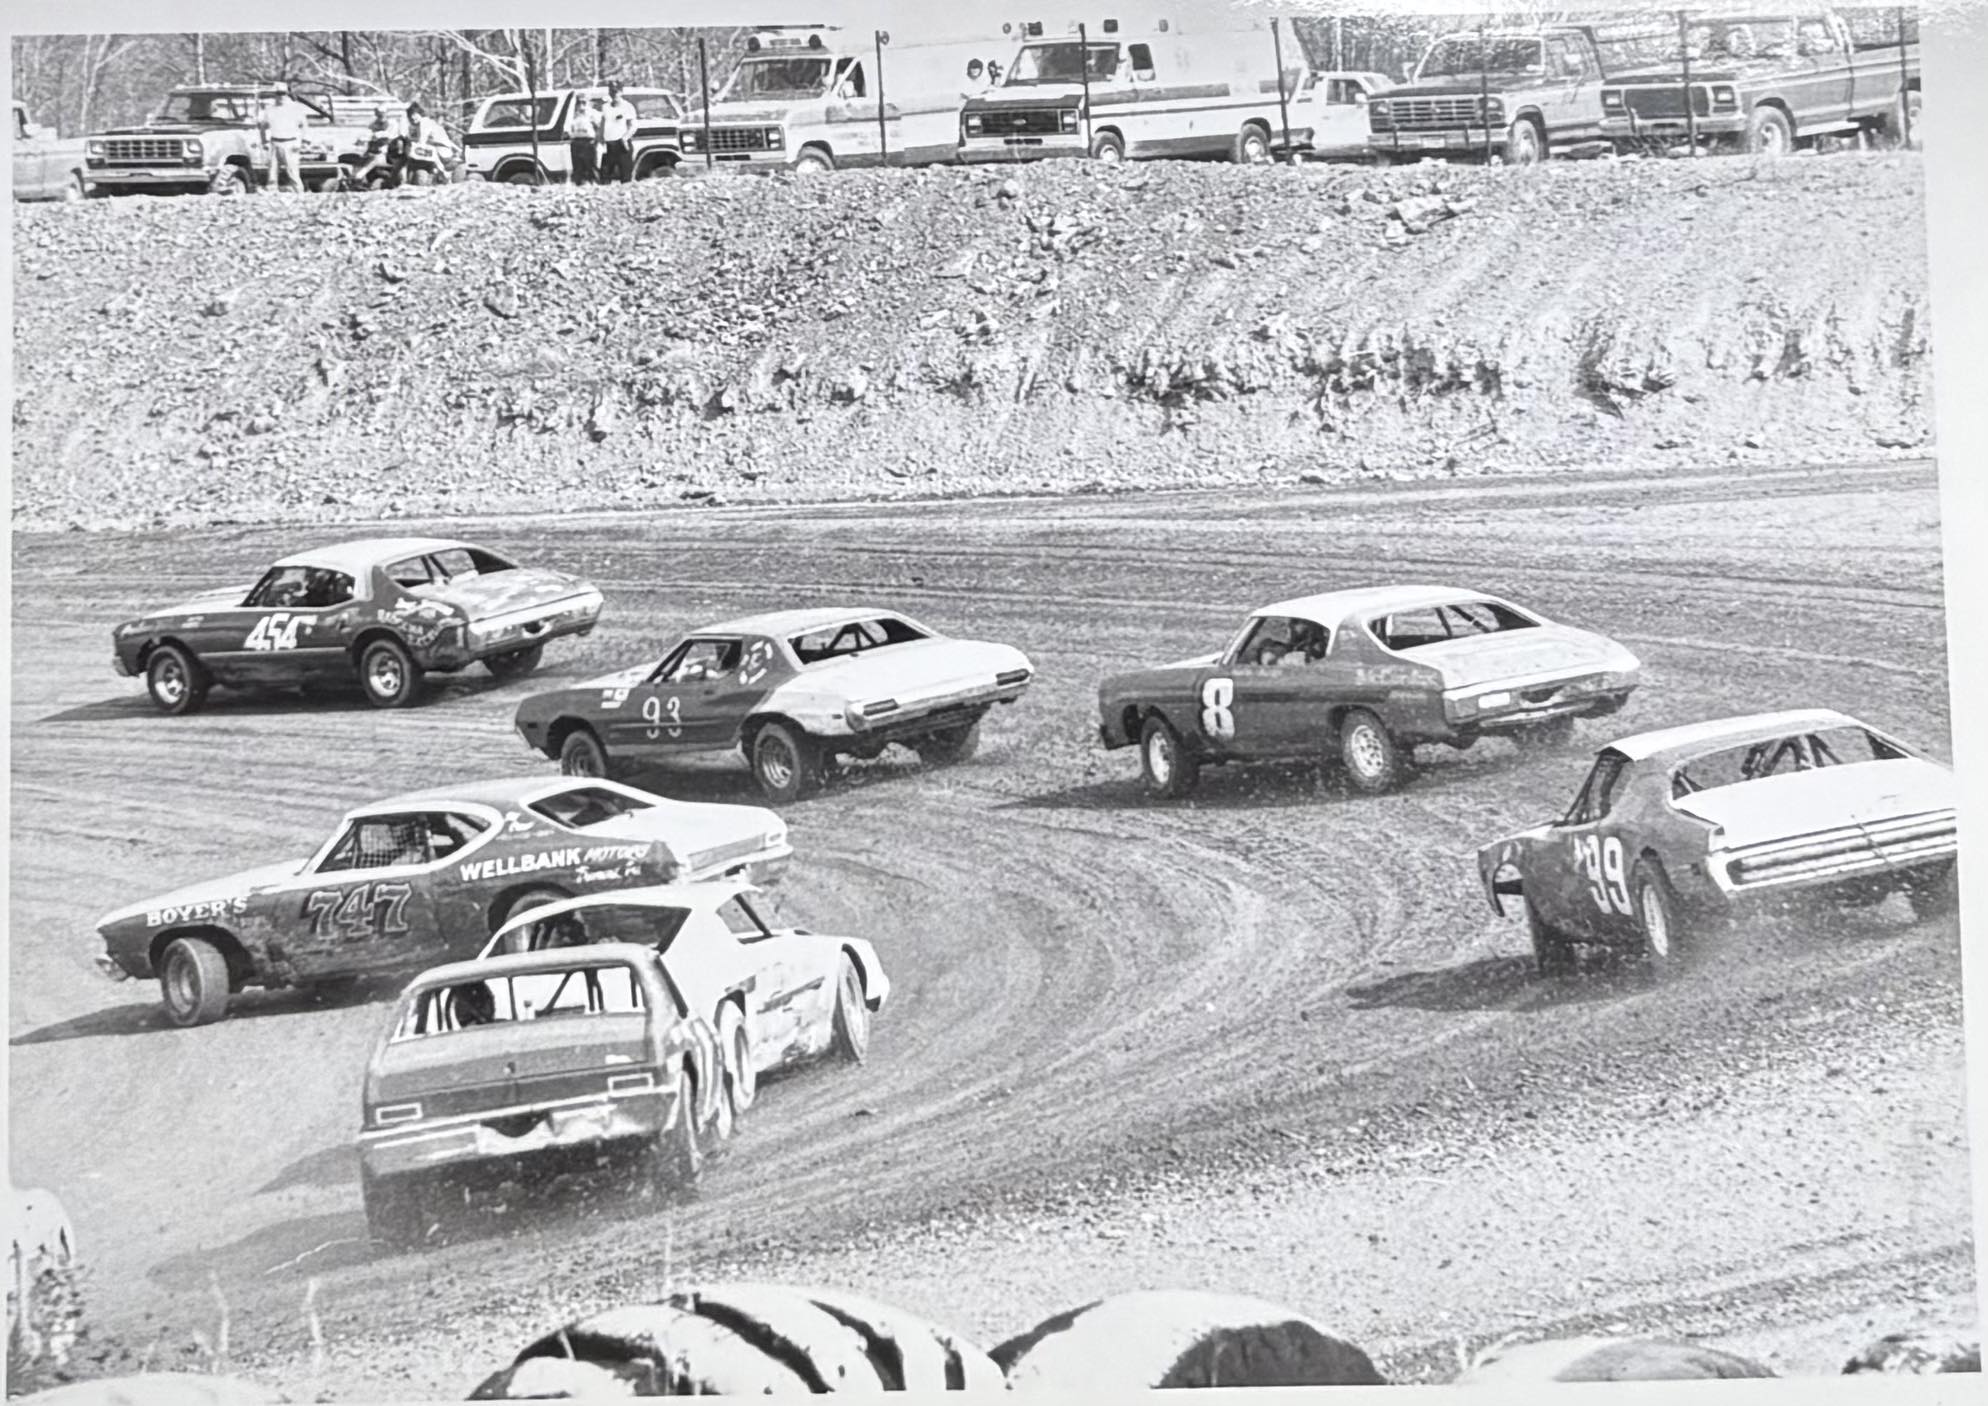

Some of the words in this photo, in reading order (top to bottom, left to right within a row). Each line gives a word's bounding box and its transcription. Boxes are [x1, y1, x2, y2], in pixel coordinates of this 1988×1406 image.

[243, 612, 300, 650] 454
[642, 696, 681, 739] 93
[1202, 677, 1235, 738] 8
[460, 848, 581, 881] WELLBANK
[146, 896, 248, 928] BOYER'S
[307, 883, 412, 940] 747
